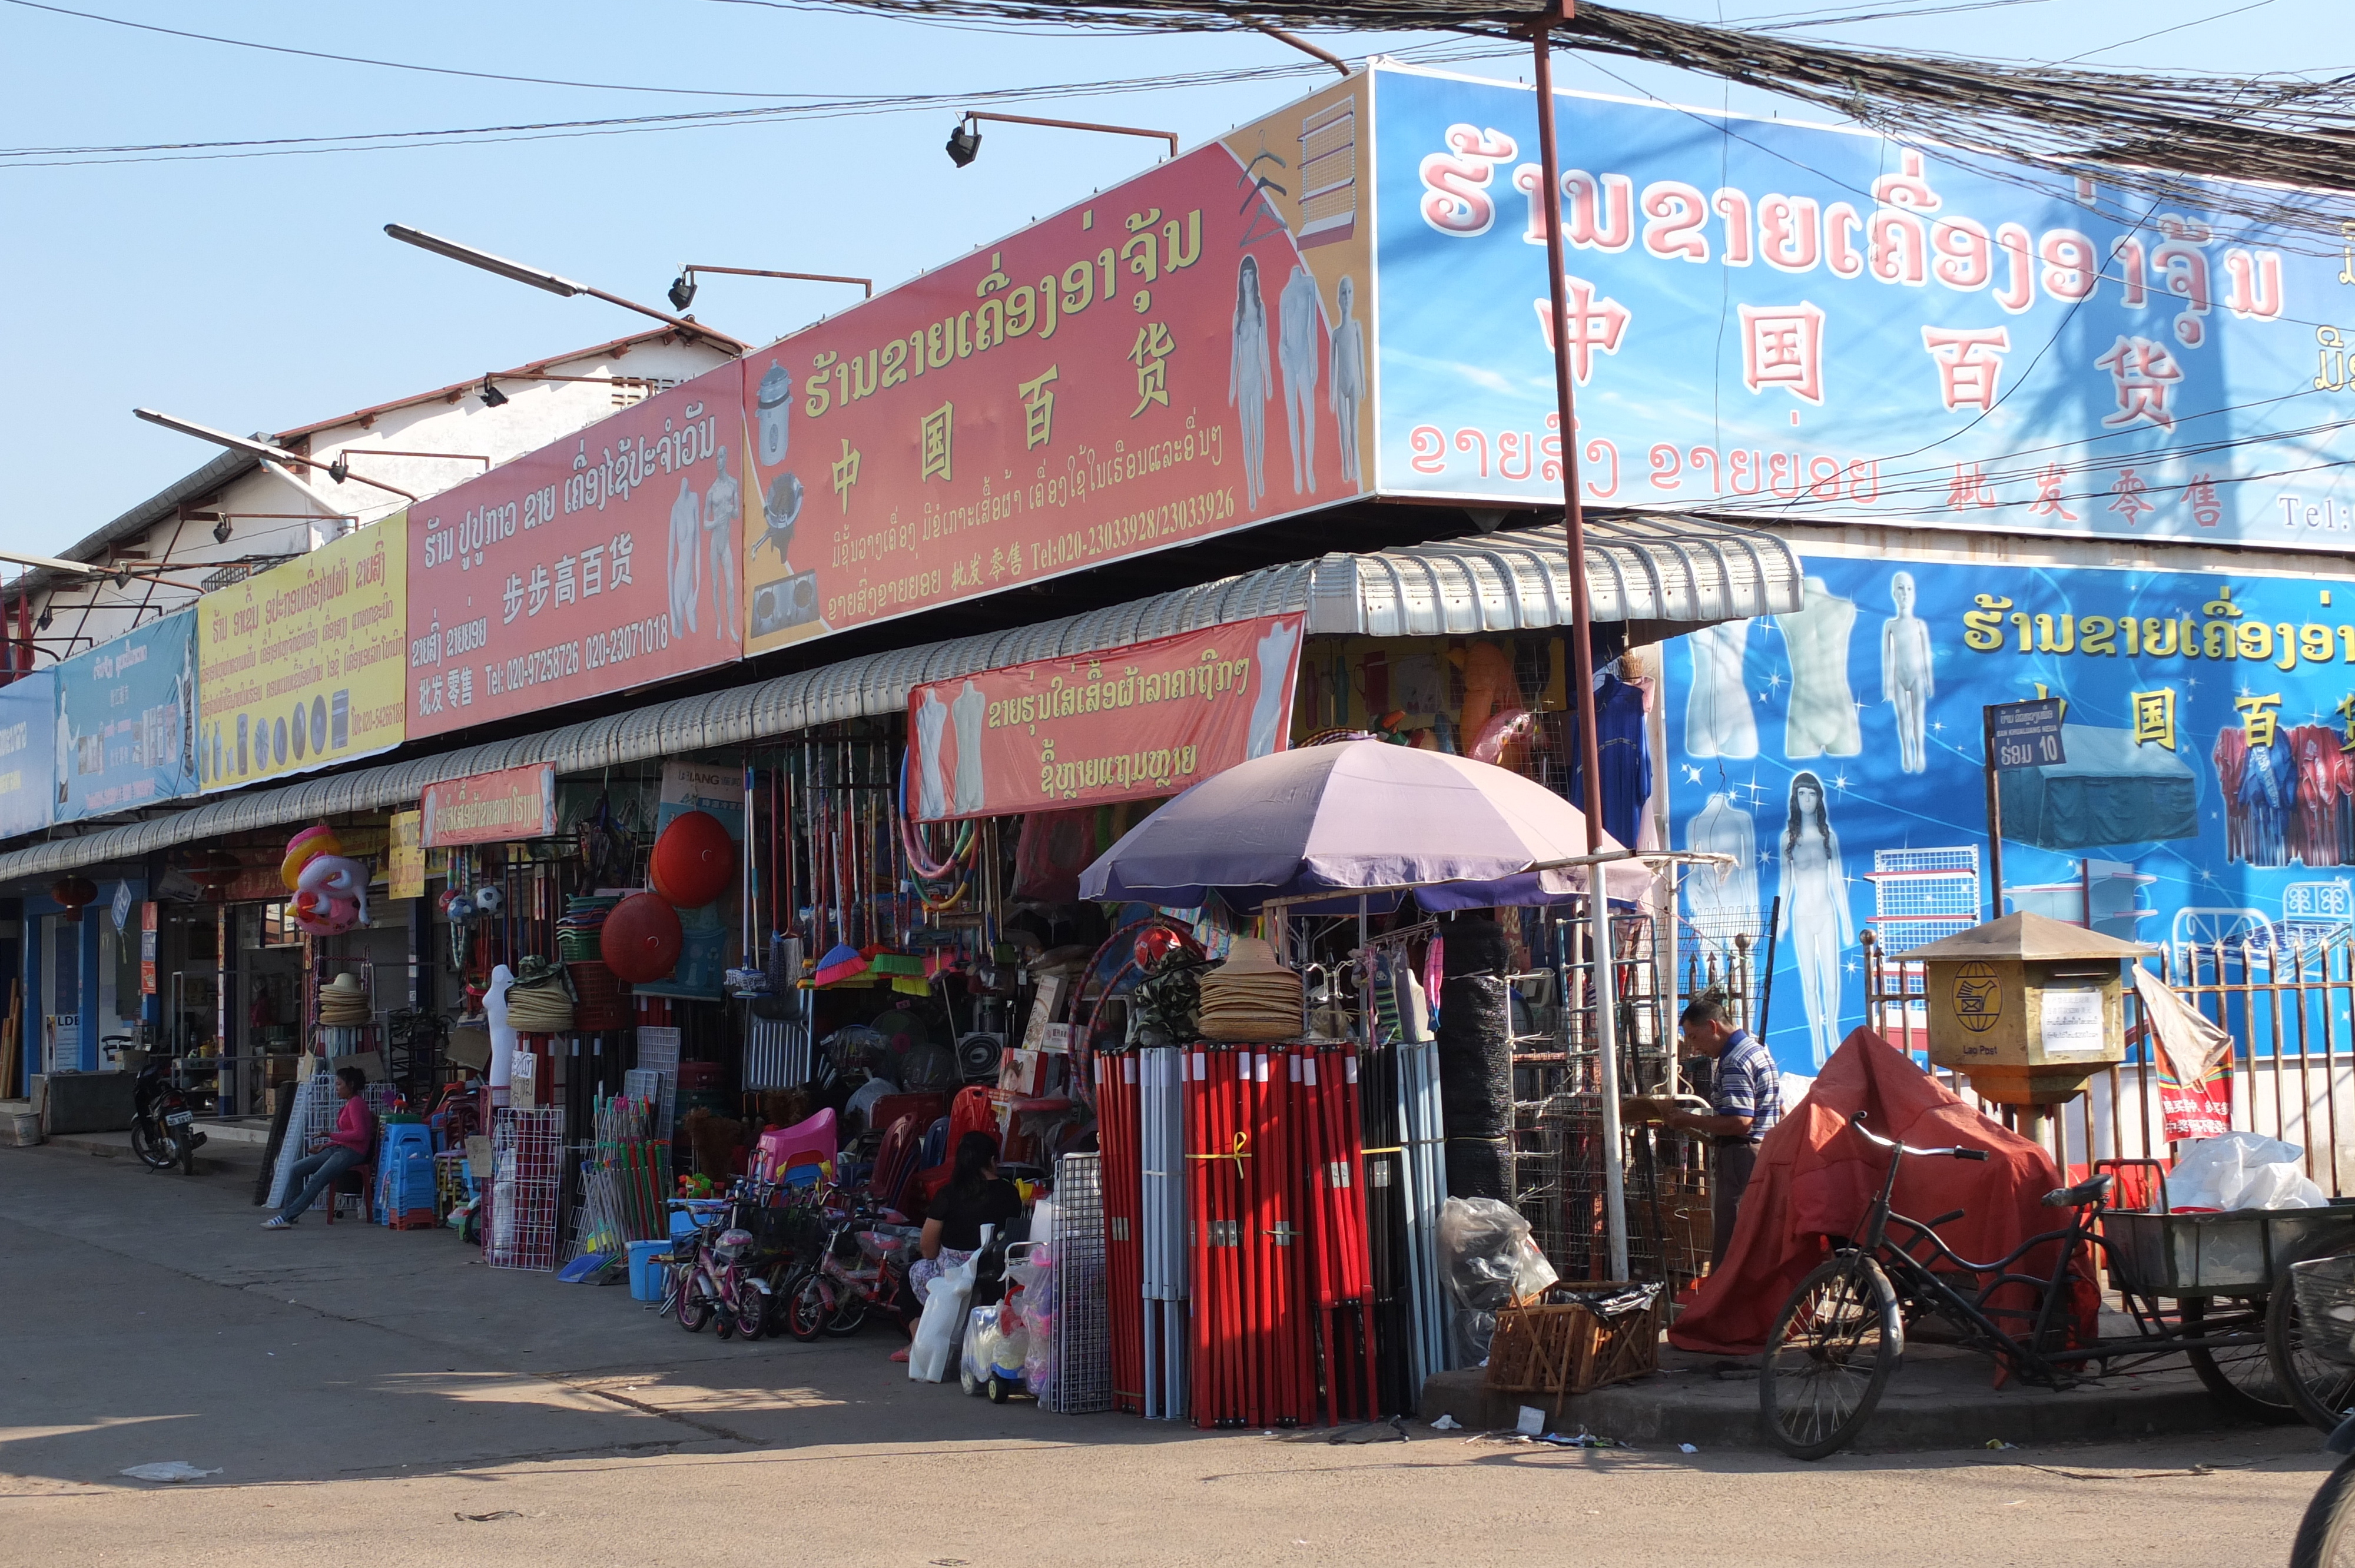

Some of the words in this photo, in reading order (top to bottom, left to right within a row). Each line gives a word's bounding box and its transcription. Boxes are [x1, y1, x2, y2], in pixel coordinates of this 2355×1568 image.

[503, 533, 633, 625] 步步高百货
[486, 665, 504, 696] Tel:
[507, 641, 579, 692] 020-97258726
[586, 613, 668, 669] 020-23071018
[2039, 735, 2058, 762] 10
[1963, 1045, 1978, 1054] Lao
[1979, 1045, 1997, 1054] Post
